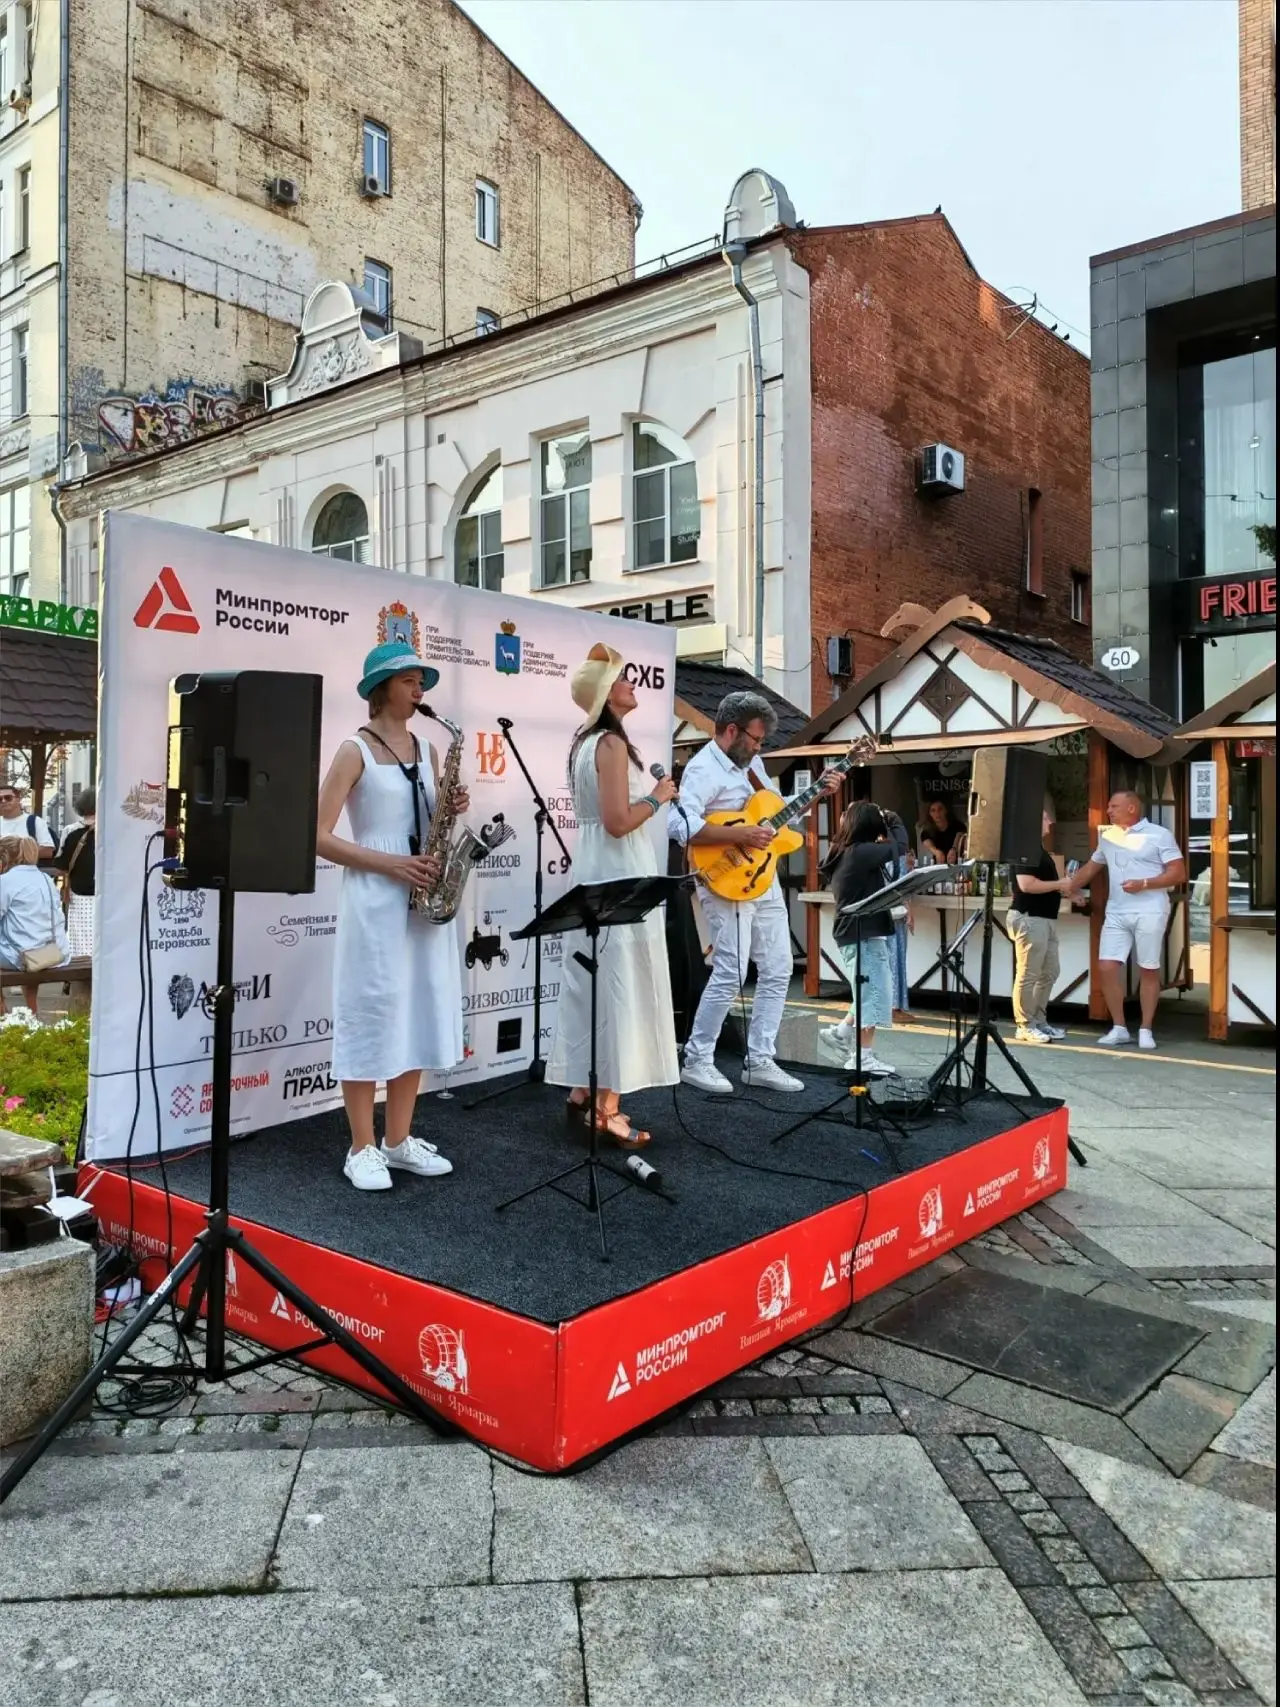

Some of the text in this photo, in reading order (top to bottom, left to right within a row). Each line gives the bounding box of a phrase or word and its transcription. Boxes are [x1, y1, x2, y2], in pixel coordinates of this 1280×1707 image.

[215, 588, 350, 626] Минпромторг
[1200, 577, 1276, 621] FRIE
[215, 609, 290, 636] России
[1111, 651, 1130, 667] 60
[150, 938, 211, 952] Перовских
[158, 926, 203, 939] Усадьба
[199, 1024, 288, 1054] ТЛЬКО
[636, 1312, 727, 1367] МИНПРОМТОРГ
[636, 1346, 688, 1387] РОССИИ
[448, 1392, 499, 1428] Ярмарка
